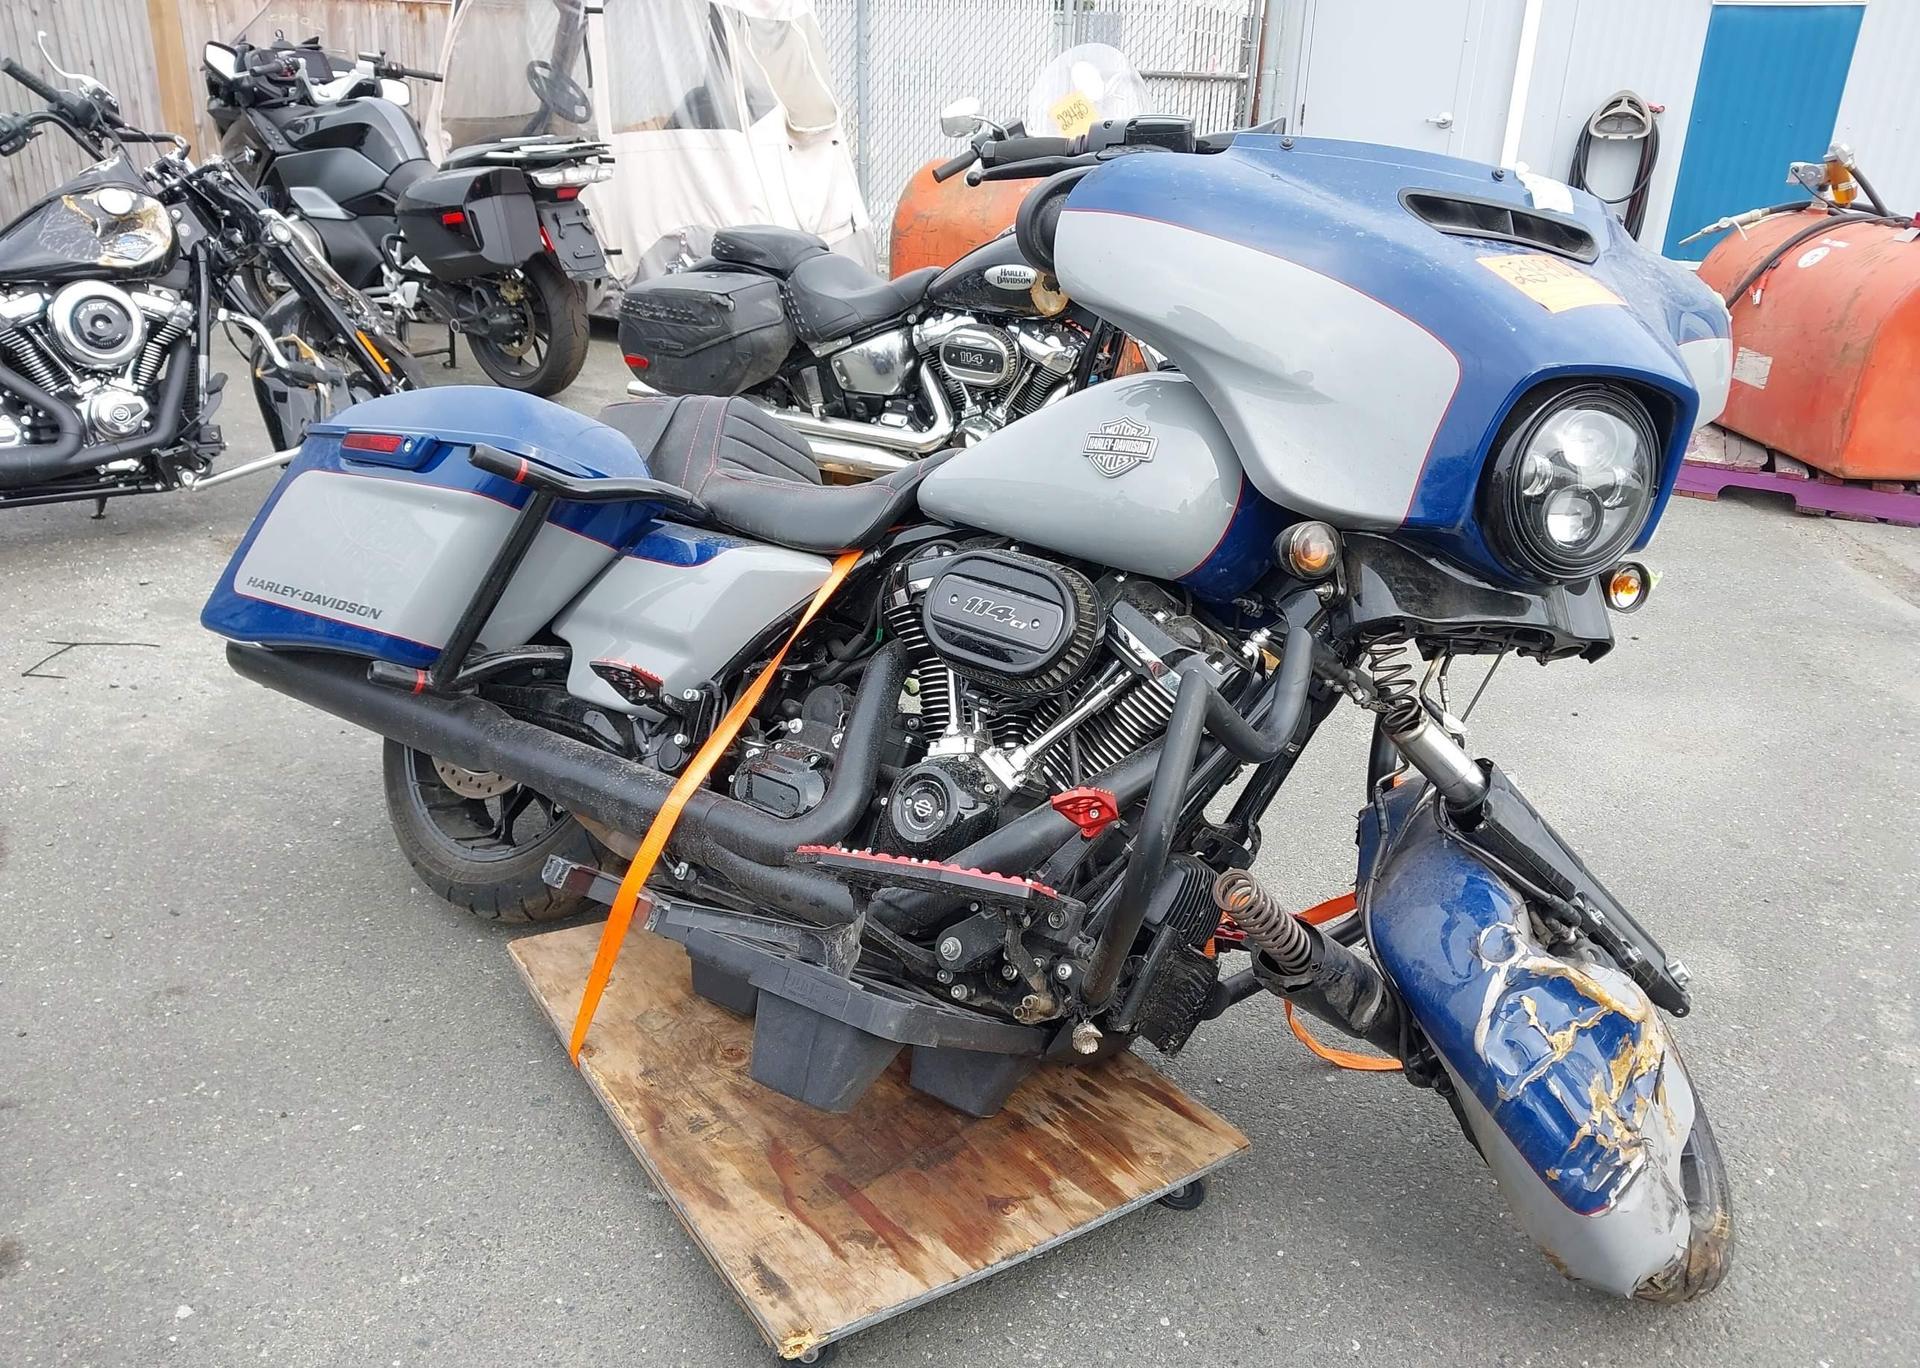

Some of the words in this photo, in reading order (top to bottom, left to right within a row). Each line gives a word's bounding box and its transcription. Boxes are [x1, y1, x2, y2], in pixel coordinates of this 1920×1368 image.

[996, 276, 1031, 285] DAVIDSON
[960, 351, 984, 365] 114
[1104, 422, 1144, 437] MOTOR
[1087, 436, 1150, 454] HARLEY-DAVIDSON
[246, 576, 383, 620] HARLEY-DAVIDSON
